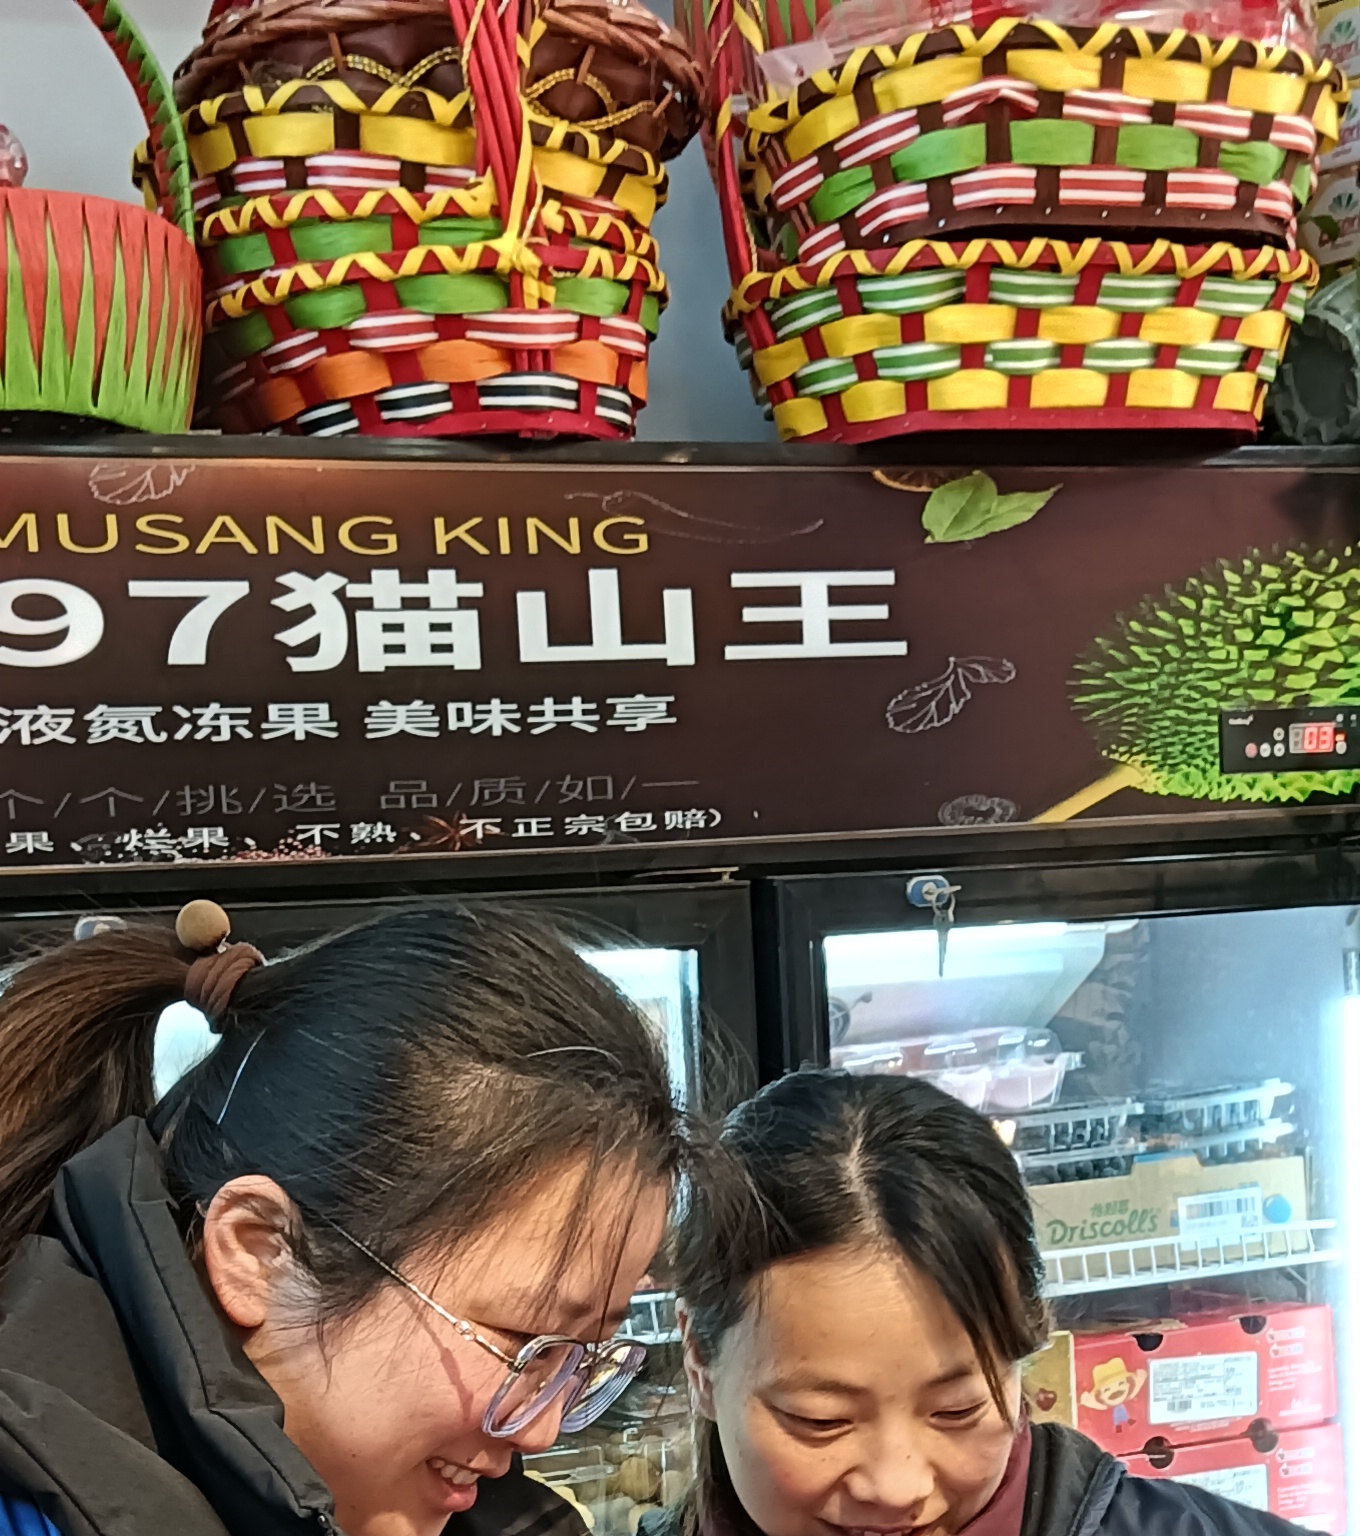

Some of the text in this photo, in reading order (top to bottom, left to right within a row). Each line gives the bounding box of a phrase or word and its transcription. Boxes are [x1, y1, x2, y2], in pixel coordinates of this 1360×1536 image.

[435, 515, 650, 556] KING
[363, 694, 678, 742] 美味共享
[379, 774, 700, 810] 品/质/如/一
[1047, 1209, 1160, 1246] Driscoll's
